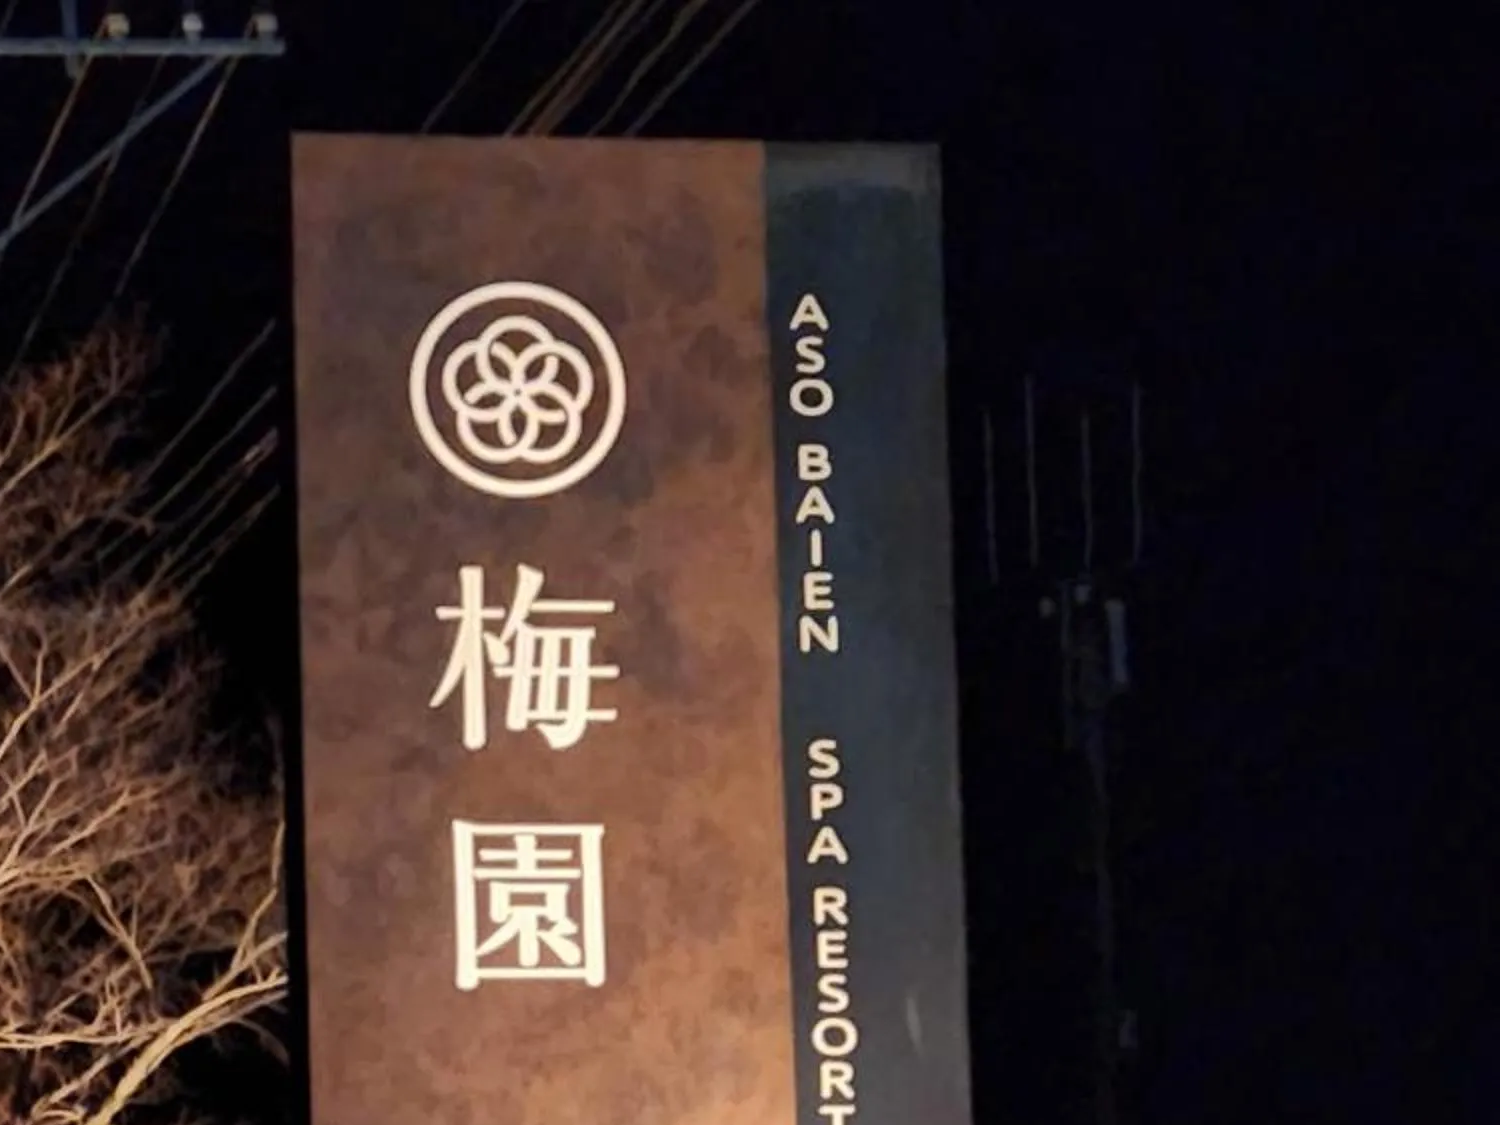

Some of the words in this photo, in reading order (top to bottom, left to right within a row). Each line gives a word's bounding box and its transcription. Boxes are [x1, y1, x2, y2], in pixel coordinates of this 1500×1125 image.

[789, 293, 834, 417] ASO
[796, 443, 839, 653] BAIEN
[428, 562, 621, 992] 梅園
[807, 738, 848, 864] SPA
